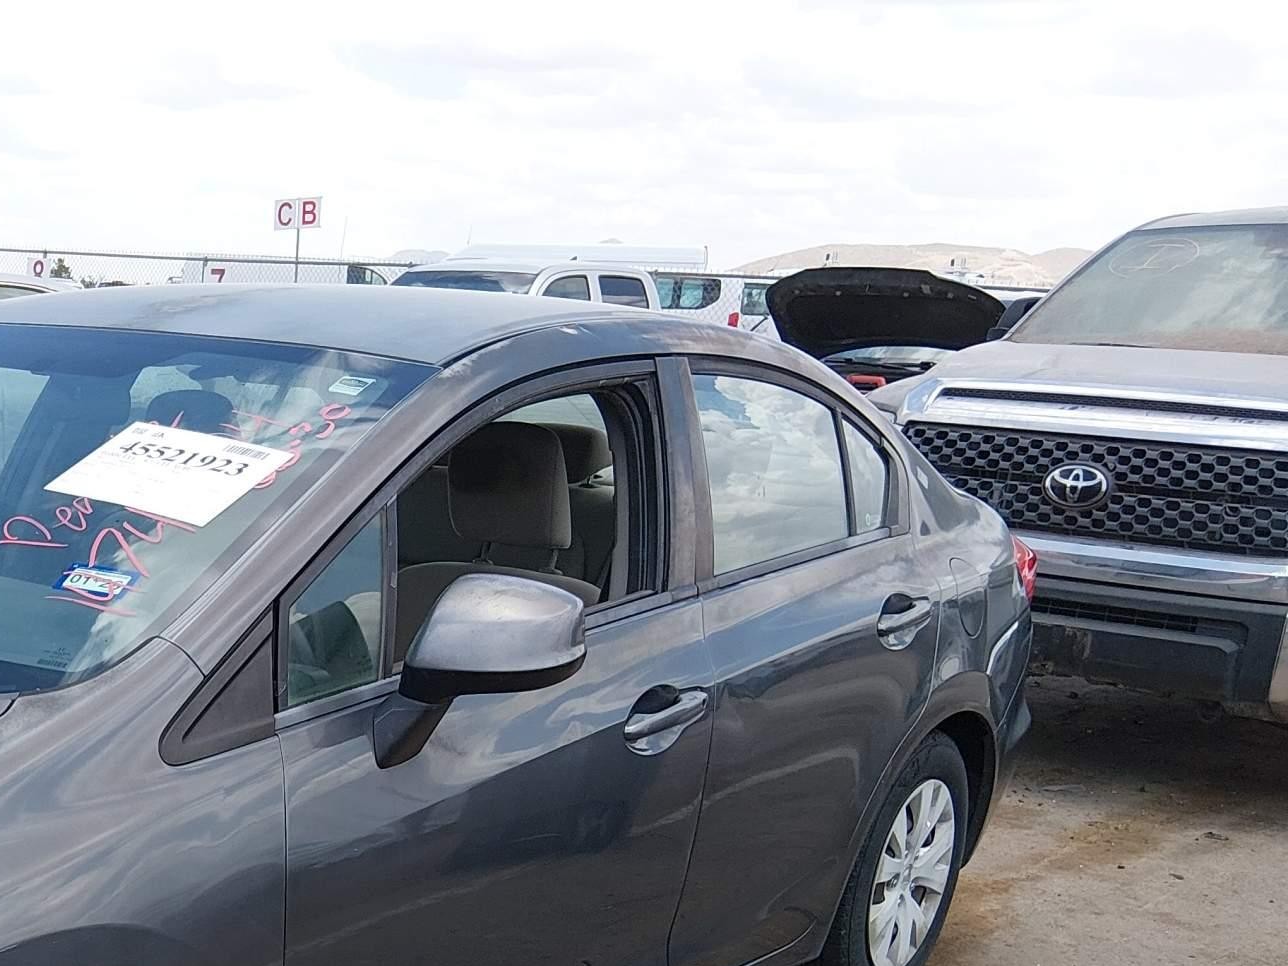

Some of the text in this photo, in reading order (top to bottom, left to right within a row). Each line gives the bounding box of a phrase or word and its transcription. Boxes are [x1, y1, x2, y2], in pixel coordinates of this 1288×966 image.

[278, 200, 317, 226] C B
[210, 268, 226, 284] 7
[119, 440, 249, 477] 45521923
